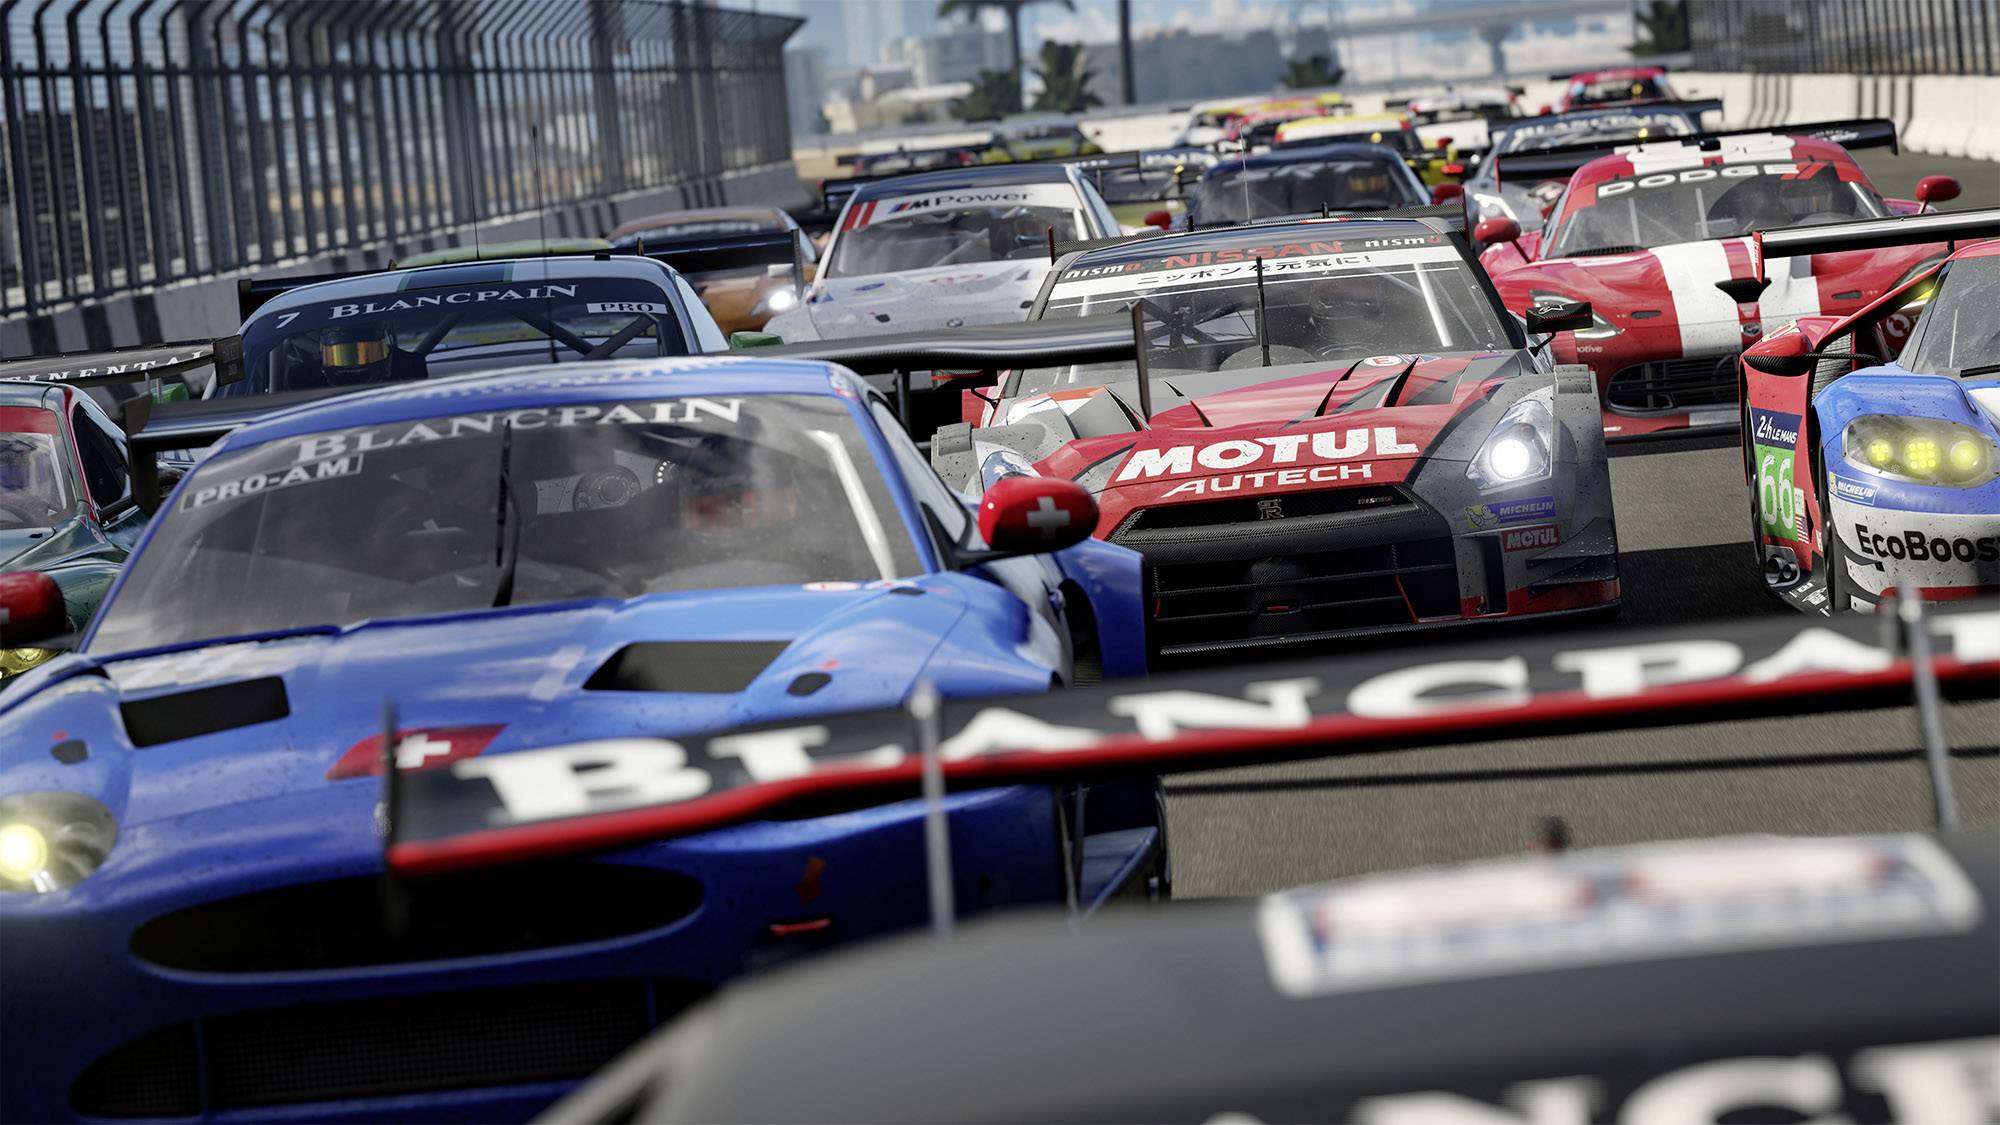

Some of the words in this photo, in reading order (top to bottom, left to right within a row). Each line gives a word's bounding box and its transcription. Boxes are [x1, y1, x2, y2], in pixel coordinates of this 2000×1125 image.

[1597, 164, 1800, 198] DODGE
[1162, 240, 1345, 270] NISSAN
[1365, 236, 1441, 247] nismo
[1065, 263, 1141, 279] nismo
[329, 284, 579, 320] BLANCPAIN
[600, 302, 655, 313] PRO
[275, 311, 301, 330] 7
[291, 398, 745, 464] BLANCPAIN
[1114, 427, 1420, 483] MOTUL
[193, 457, 351, 508] PRO-AM
[1159, 463, 1373, 498] AUTECH
[1761, 454, 1793, 530] 66
[1838, 480, 1875, 498] MICHELIN
[1500, 501, 1554, 517] MICHELIN
[1506, 528, 1558, 549] MOTUL
[1854, 522, 2000, 563] EcoBoos
